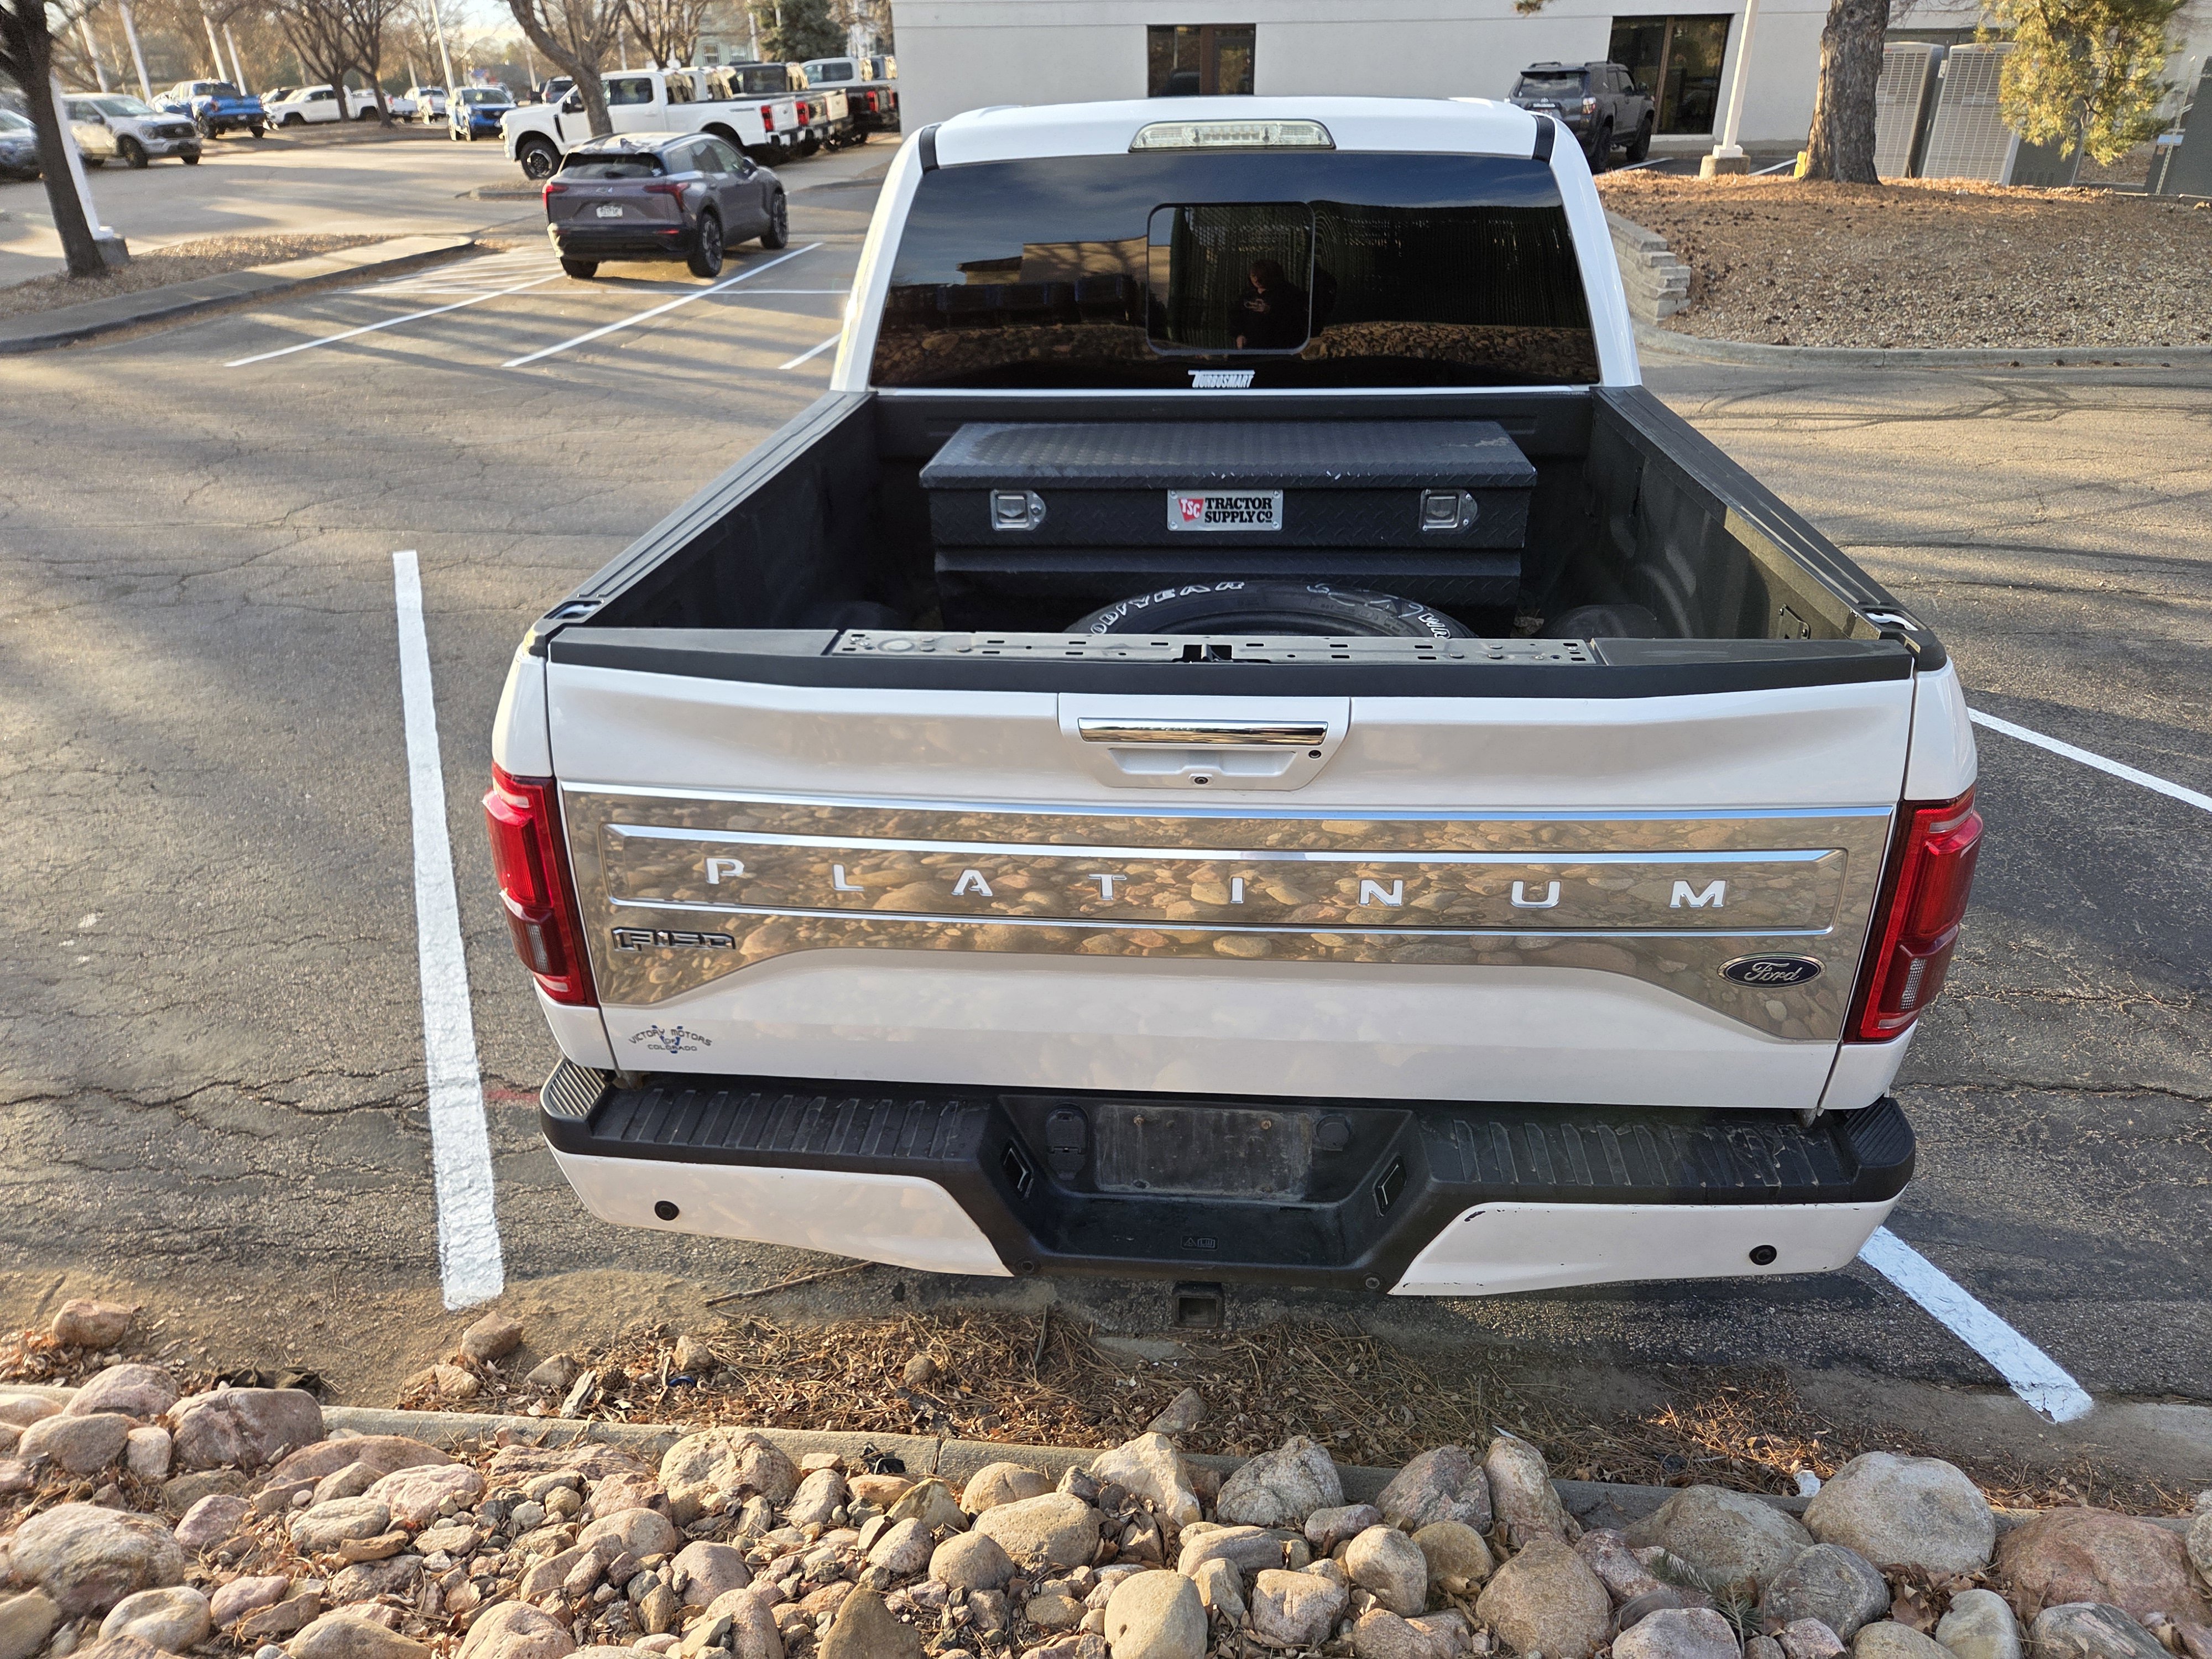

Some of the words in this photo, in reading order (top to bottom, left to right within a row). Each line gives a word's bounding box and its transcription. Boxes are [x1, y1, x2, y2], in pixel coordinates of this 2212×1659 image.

[1180, 498, 1201, 518] TSC
[1204, 497, 1272, 510] TRACTOR
[1204, 510, 1256, 523] SUPPLY
[1090, 581, 1245, 634] ODYEAR
[705, 857, 1730, 909] PLATINUM
[1744, 962, 1803, 981] Ford
[628, 1028, 665, 1044] VICTORY
[671, 1029, 713, 1047] MOTORS
